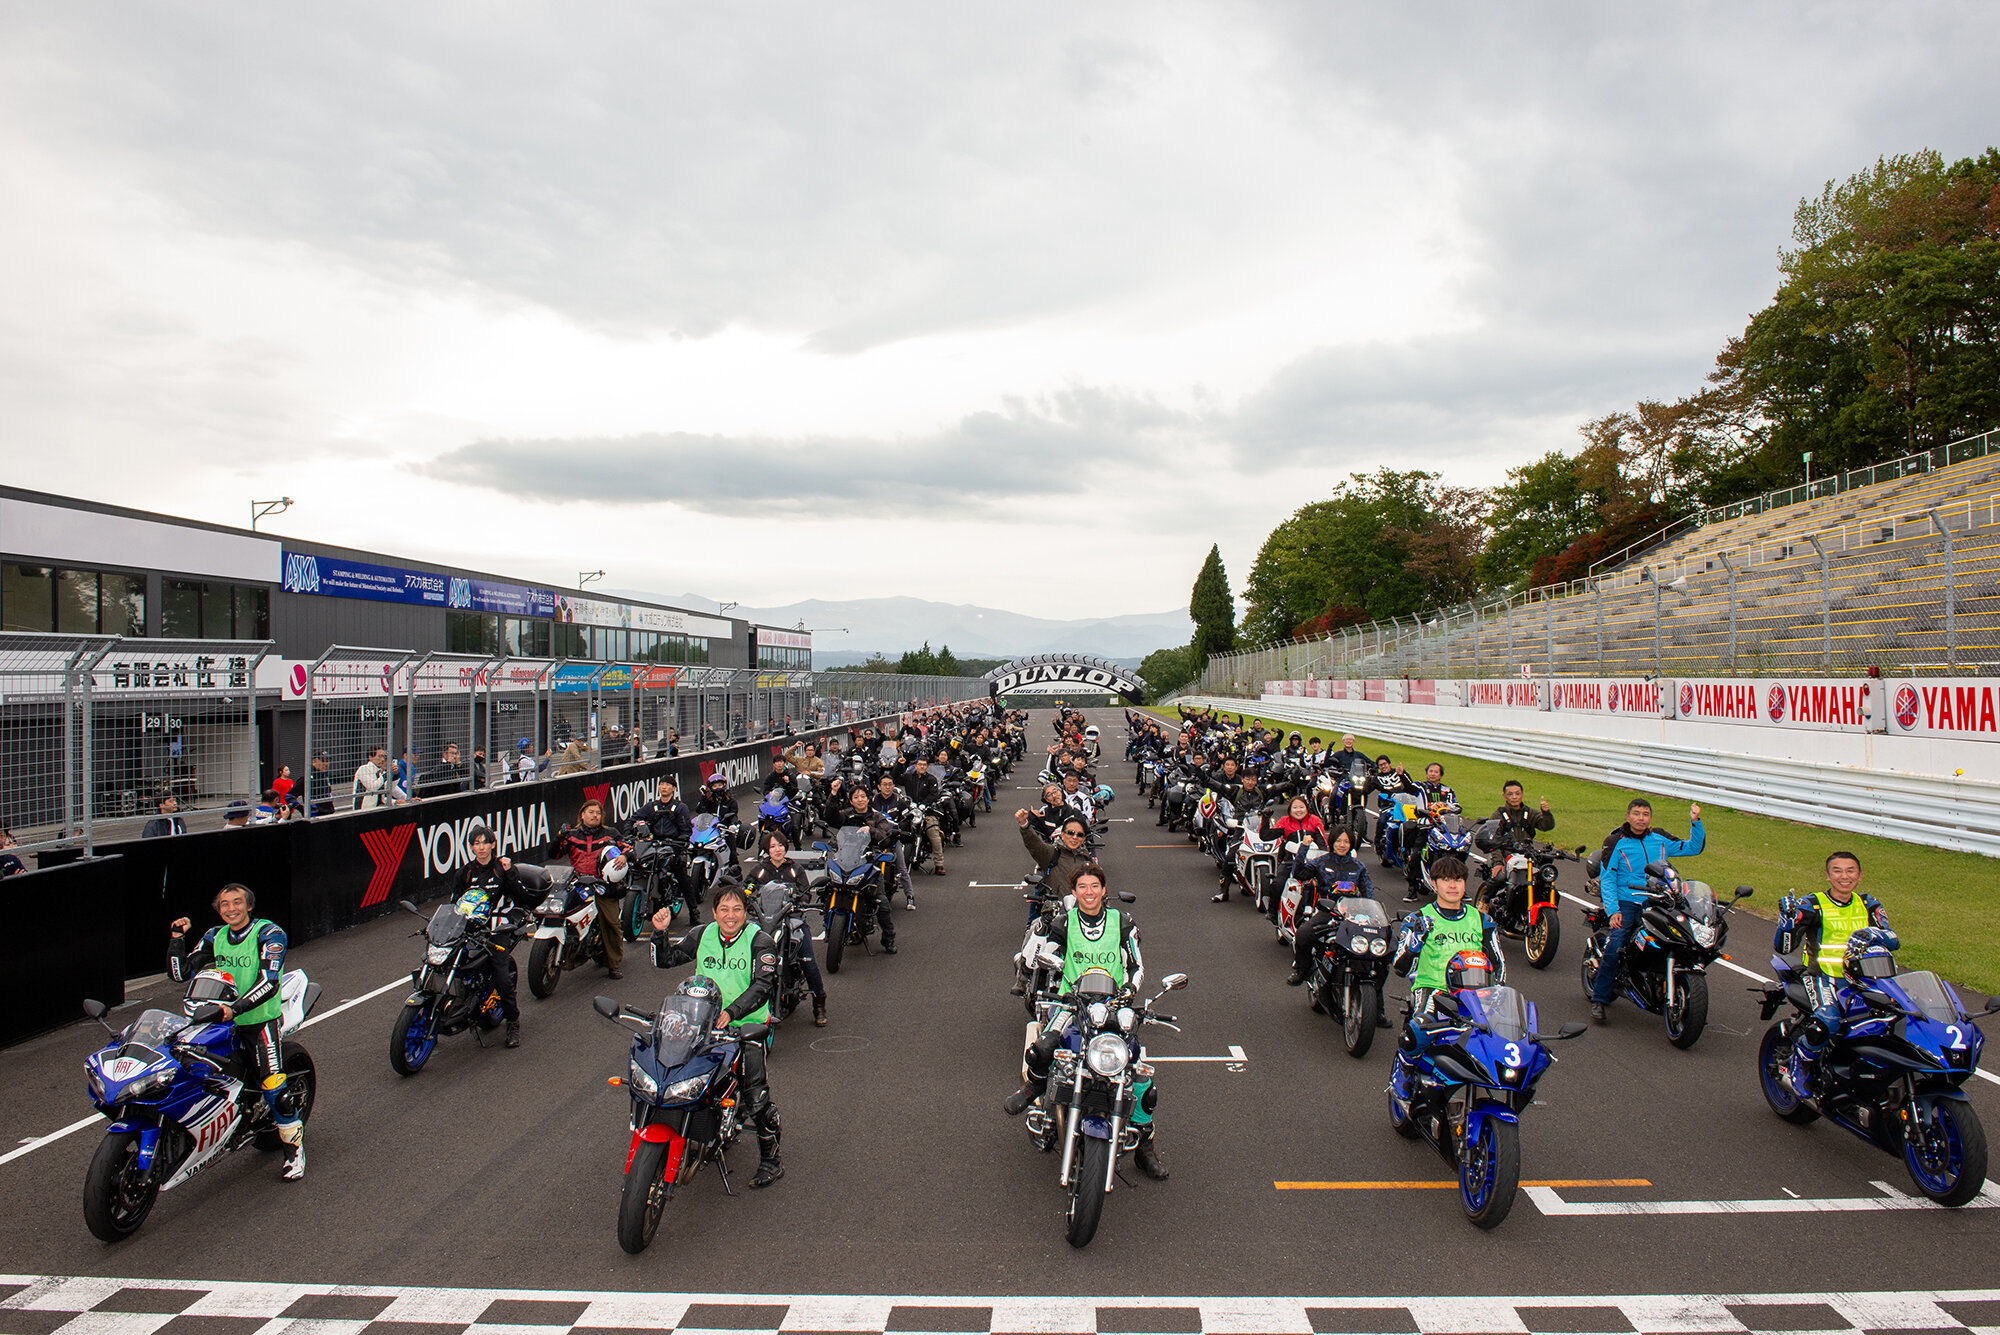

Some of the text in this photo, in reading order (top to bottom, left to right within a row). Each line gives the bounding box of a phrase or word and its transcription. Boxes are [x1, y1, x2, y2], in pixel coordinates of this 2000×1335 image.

[284, 553, 319, 592] ASKA
[404, 574, 444, 592] アスカ株式会社
[995, 664, 1136, 695] DUNLOP
[1476, 683, 1502, 705] YAMAHA
[1563, 683, 1602, 710] YAMAHA
[1620, 683, 1660, 713] YAMAH
[1695, 684, 1757, 719] YAMAHA
[364, 709, 389, 718] 31 32
[1922, 686, 2000, 732] YAMA
[147, 717, 182, 729] 29 30
[610, 772, 682, 824] YOKOHAA
[1447, 932, 1480, 944] SUGO
[226, 956, 251, 968] SUGO
[716, 957, 747, 970] SUGO
[1085, 952, 1116, 964] SUGO
[249, 982, 274, 1003] YAMAHA
[1946, 1025, 1966, 1049] 2
[267, 1041, 279, 1075] YAMAHA
[1504, 1042, 1521, 1067] 3
[114, 1061, 133, 1074] FIAT
[198, 1103, 235, 1153] FIAT
